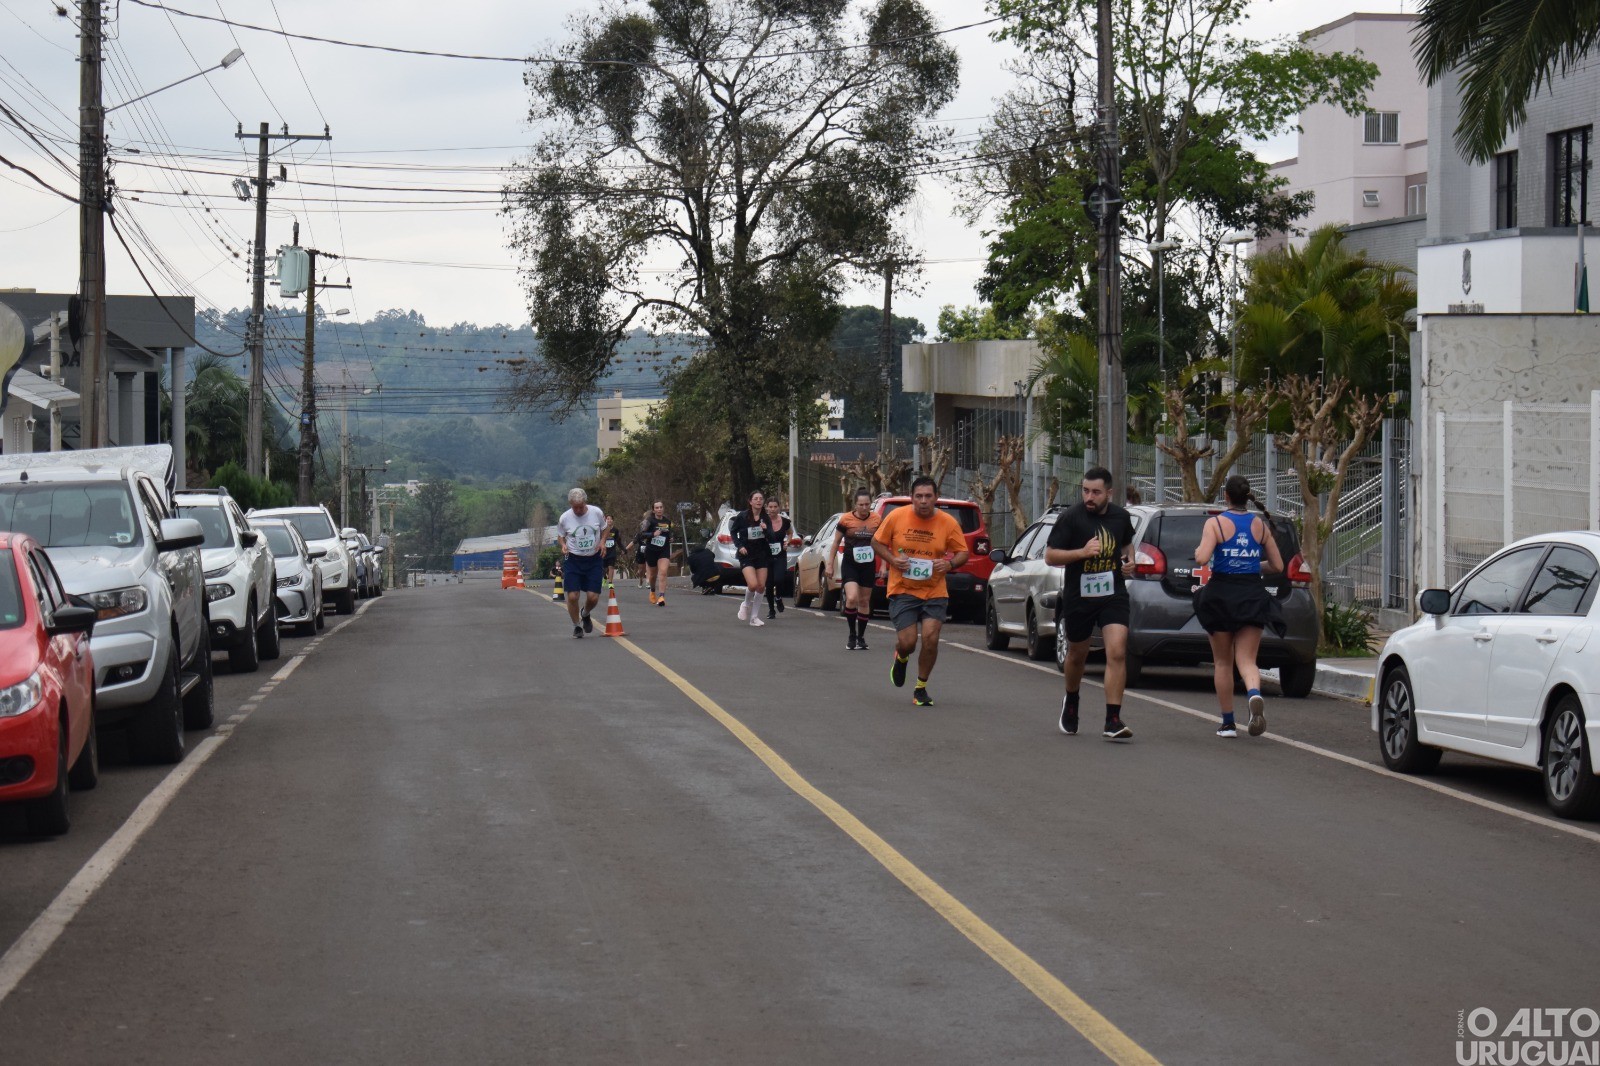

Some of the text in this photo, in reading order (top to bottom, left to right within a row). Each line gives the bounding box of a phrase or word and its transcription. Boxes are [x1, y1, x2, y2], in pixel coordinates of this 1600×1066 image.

[578, 540, 594, 548] 327
[856, 552, 872, 561] 301
[1222, 548, 1260, 558] TEAM
[1084, 559, 1117, 573] GARRA
[1083, 581, 1110, 594] 111
